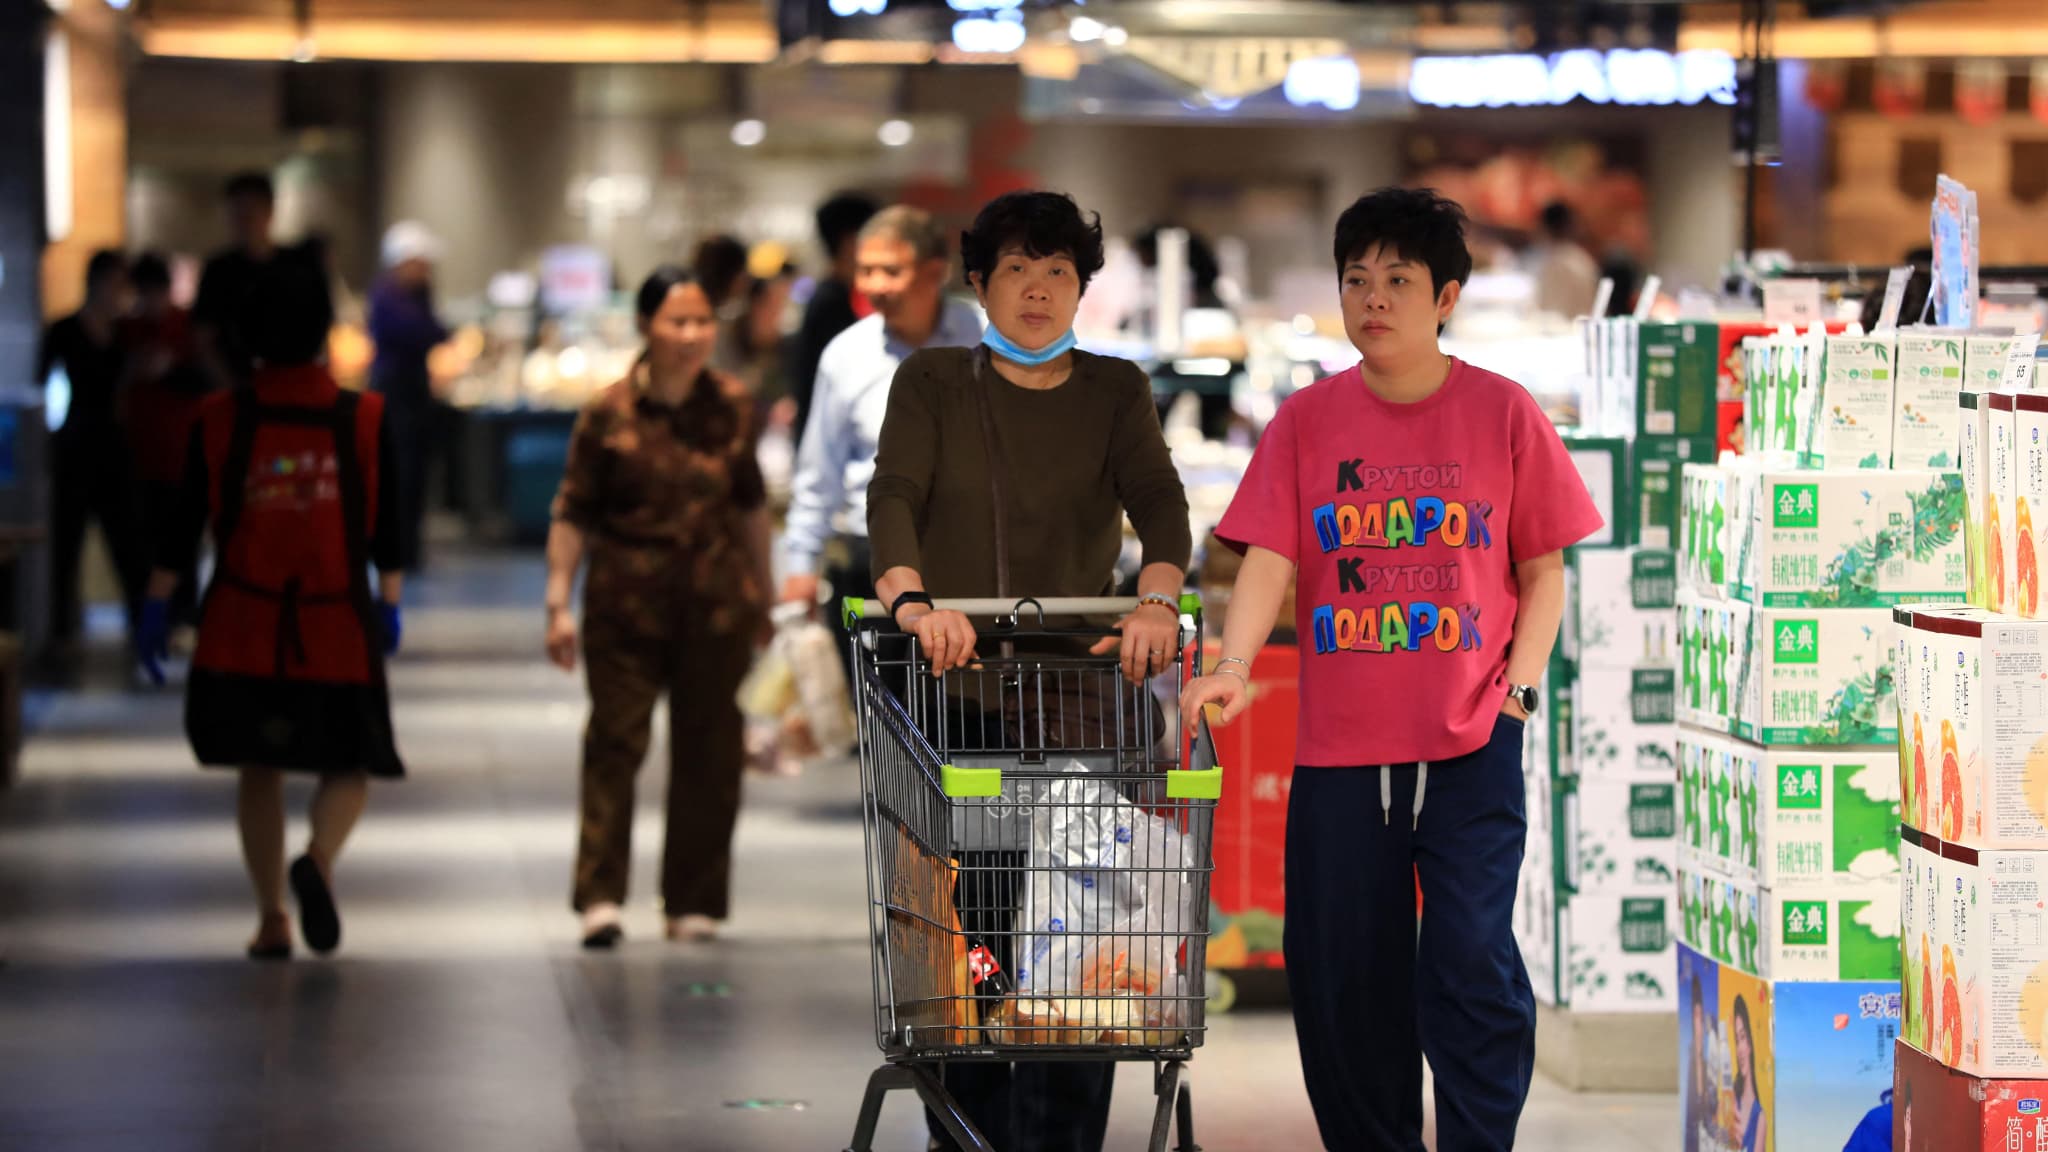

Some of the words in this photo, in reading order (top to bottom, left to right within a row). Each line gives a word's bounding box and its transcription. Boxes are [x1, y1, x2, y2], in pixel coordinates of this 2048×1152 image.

[1777, 488, 1814, 516] 金典
[1312, 496, 1493, 553] ПОДАРОК
[1312, 600, 1482, 654] ПОДАРОК
[1777, 624, 1814, 652] 金典
[1781, 769, 1818, 797] 金典
[1786, 905, 1824, 933] 金典
